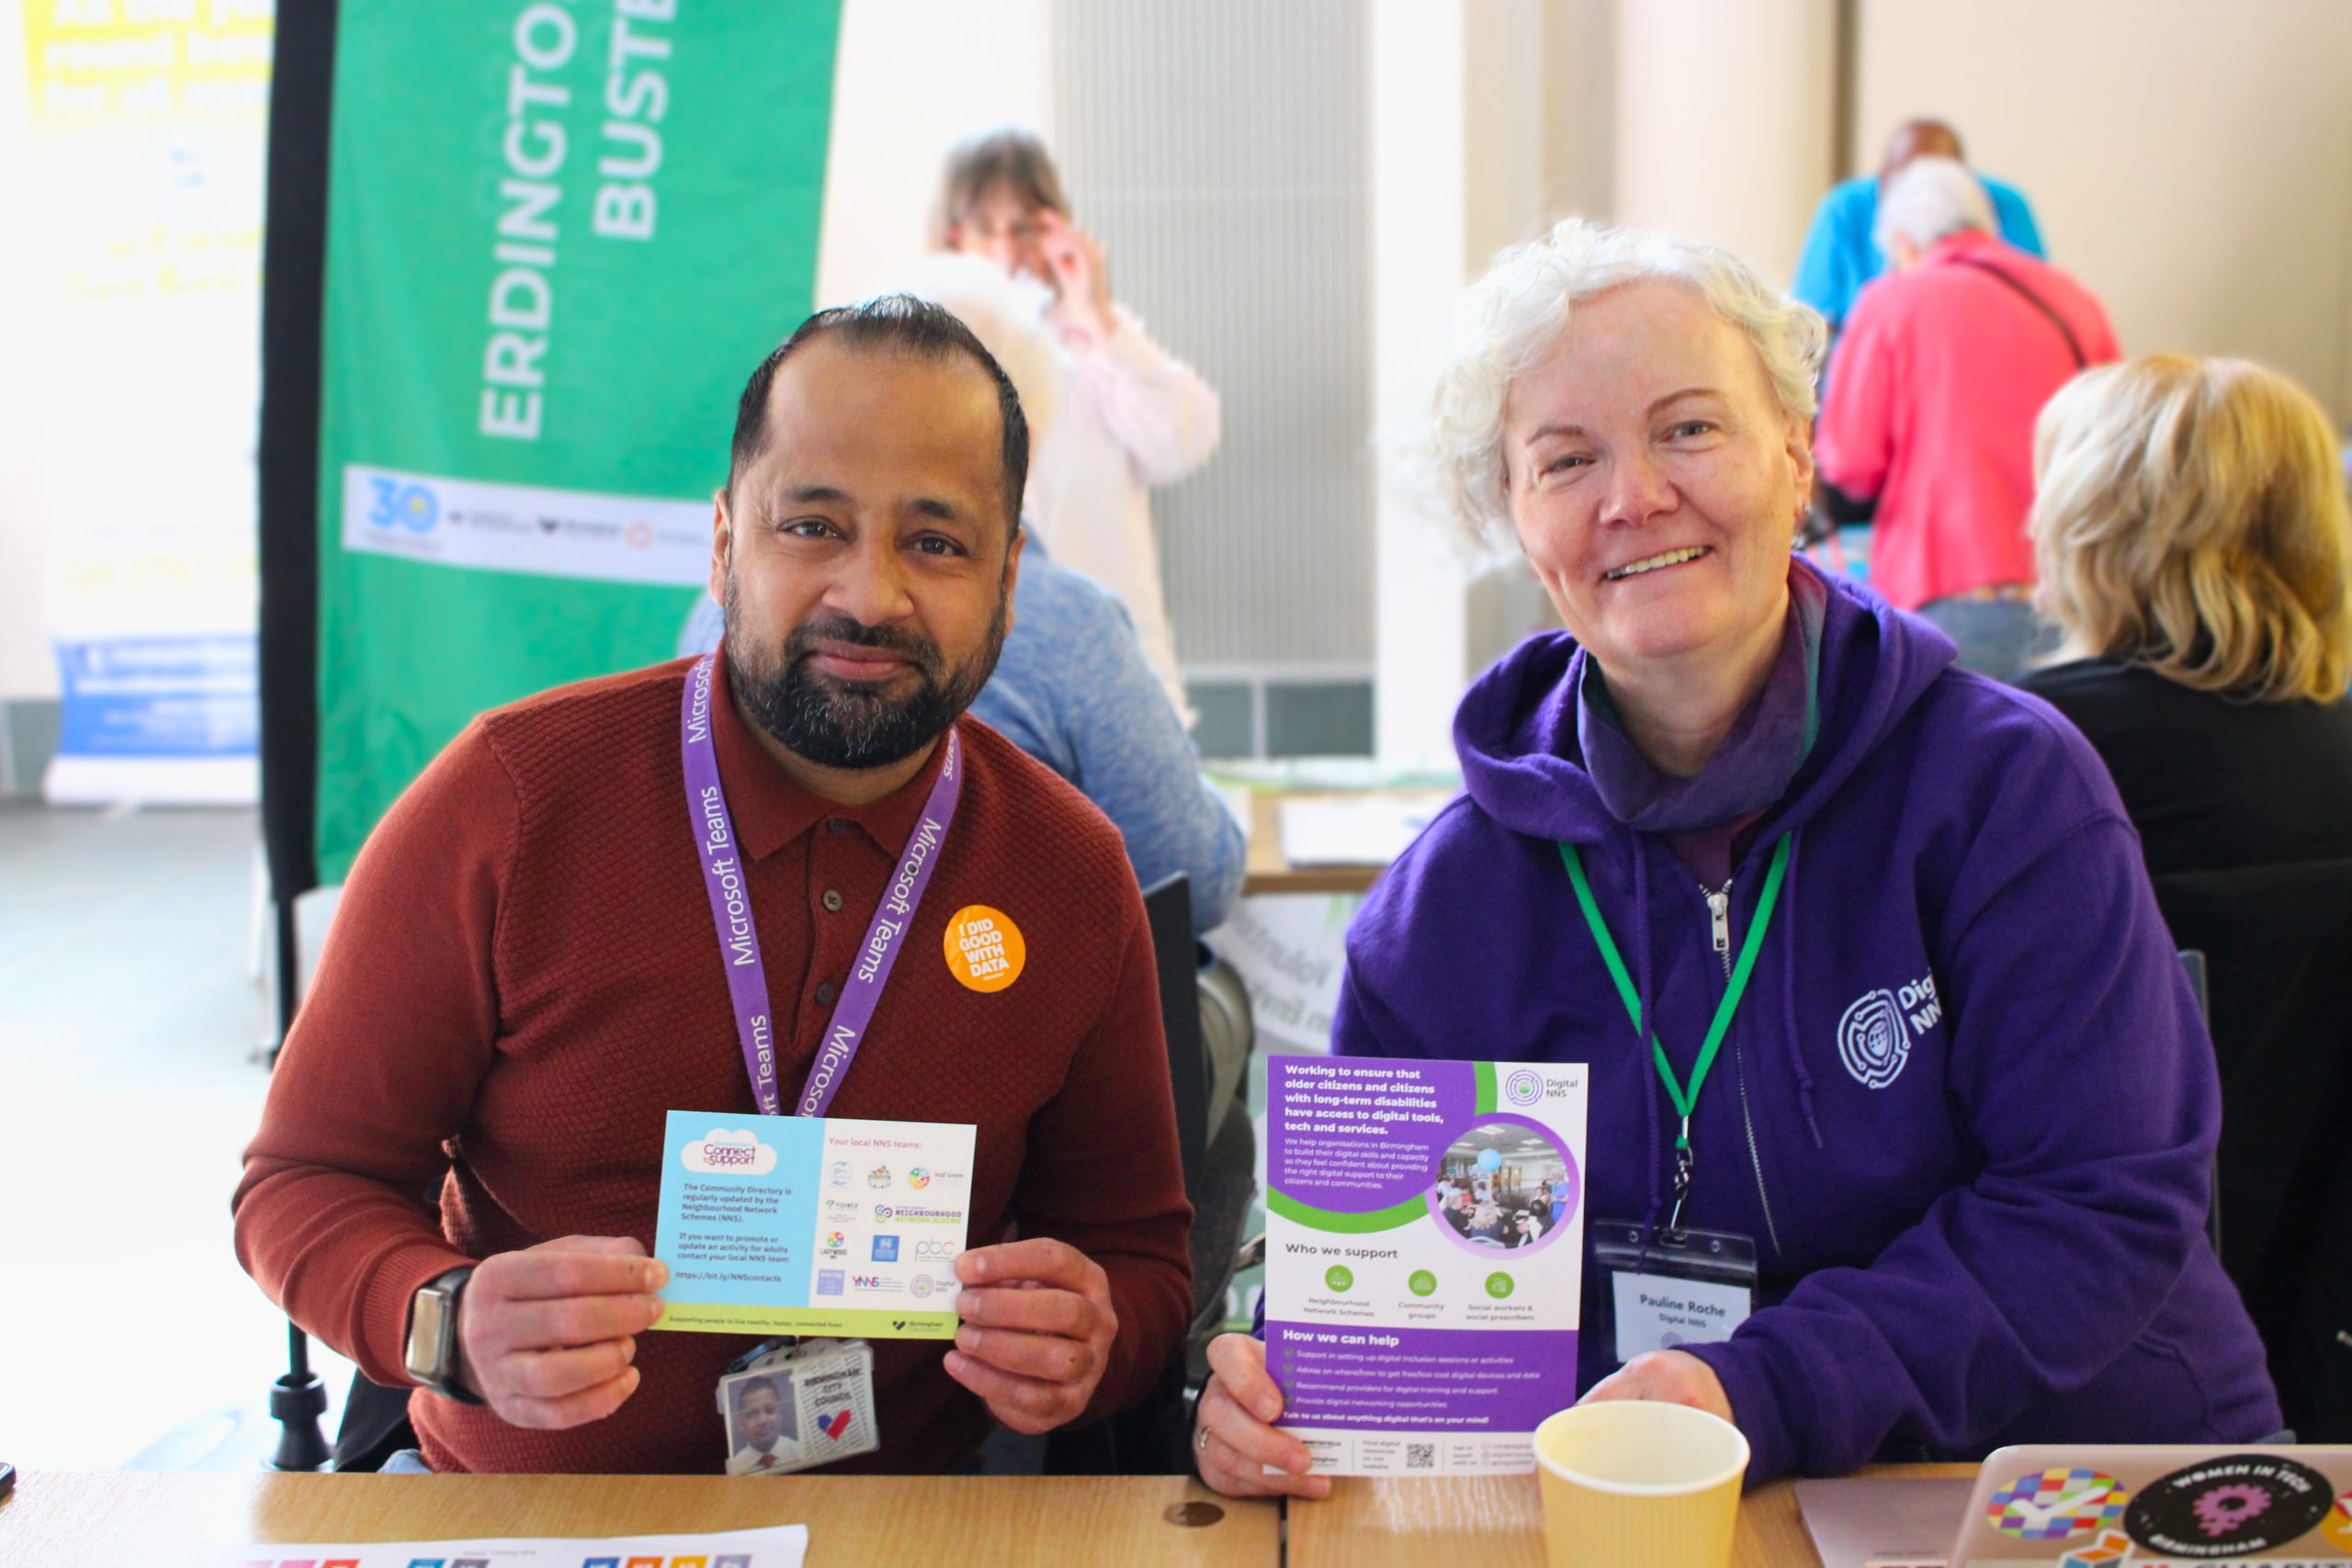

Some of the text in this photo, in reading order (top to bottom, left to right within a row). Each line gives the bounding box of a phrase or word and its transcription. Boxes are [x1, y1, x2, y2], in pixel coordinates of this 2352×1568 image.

[479, 0, 578, 441] ERDINGTO
[368, 475, 440, 533] 30
[688, 659, 712, 743] Microsoft
[701, 785, 755, 965] Microsoft Teams
[858, 818, 942, 984] Microsoft Teams
[959, 919, 994, 937] I DID
[959, 930, 1002, 951] GOOD
[965, 943, 1005, 964] WITH
[969, 957, 1010, 977] DATA
[1898, 970, 1936, 1010] Dig
[1909, 998, 1942, 1035] NN
[751, 1015, 773, 1090] Teams
[801, 1025, 856, 1118] Microso
[1285, 1066, 1335, 1077] Working
[1339, 1067, 1351, 1077] to
[1396, 1069, 1419, 1078] that
[1284, 1079, 1434, 1093] older citizens and citizens
[1546, 1078, 1577, 1091] Digital
[1285, 1093, 1436, 1108] with long-term disabilities
[1546, 1089, 1566, 1098] NNS
[1284, 1107, 1443, 1123] have access to digital tools,
[1284, 1122, 1388, 1134] tech and services.
[704, 1144, 755, 1157] Connect
[1299, 1139, 1317, 1147] help
[1318, 1140, 1369, 1149] organisations
[1380, 1142, 1428, 1152] Birmingham
[1335, 1150, 1358, 1158] digital
[1396, 1153, 1429, 1162] capacity
[1295, 1158, 1311, 1167] they
[1391, 1163, 1428, 1171] providing
[1299, 1168, 1317, 1177] right
[1318, 1169, 1342, 1178] digital
[1344, 1170, 1374, 1179] support
[700, 1184, 745, 1193] Community
[747, 1186, 783, 1195] Directory
[683, 1193, 718, 1202] regularly
[719, 1195, 752, 1204] updated
[754, 1196, 763, 1204] by
[682, 1203, 777, 1213] Neighbourhood Network
[681, 1213, 744, 1223] Schemes (NNS).
[735, 1235, 768, 1244] promote
[678, 1242, 706, 1251] update
[719, 1244, 749, 1252] activity
[1285, 1243, 1398, 1259] Who we support
[675, 1271, 781, 1282] https://bit.ly/NNScontacts
[1308, 1298, 1370, 1308] Neighbourhood
[1398, 1302, 1445, 1312] Community
[1640, 1294, 1725, 1317] Pauline Roche
[1304, 1307, 1374, 1318] Network Schemes
[1659, 1314, 1706, 1328] Digital NNS
[1283, 1329, 1399, 1348] How we can help
[1296, 1351, 1326, 1359] Support
[1337, 1353, 1363, 1361] setting
[1346, 1415, 1382, 1423] anything
[1384, 1416, 1408, 1424] digital
[2172, 1464, 2312, 1494] WOMEN IN TECH
[2148, 1534, 2267, 1556] BIRMINGHAM
